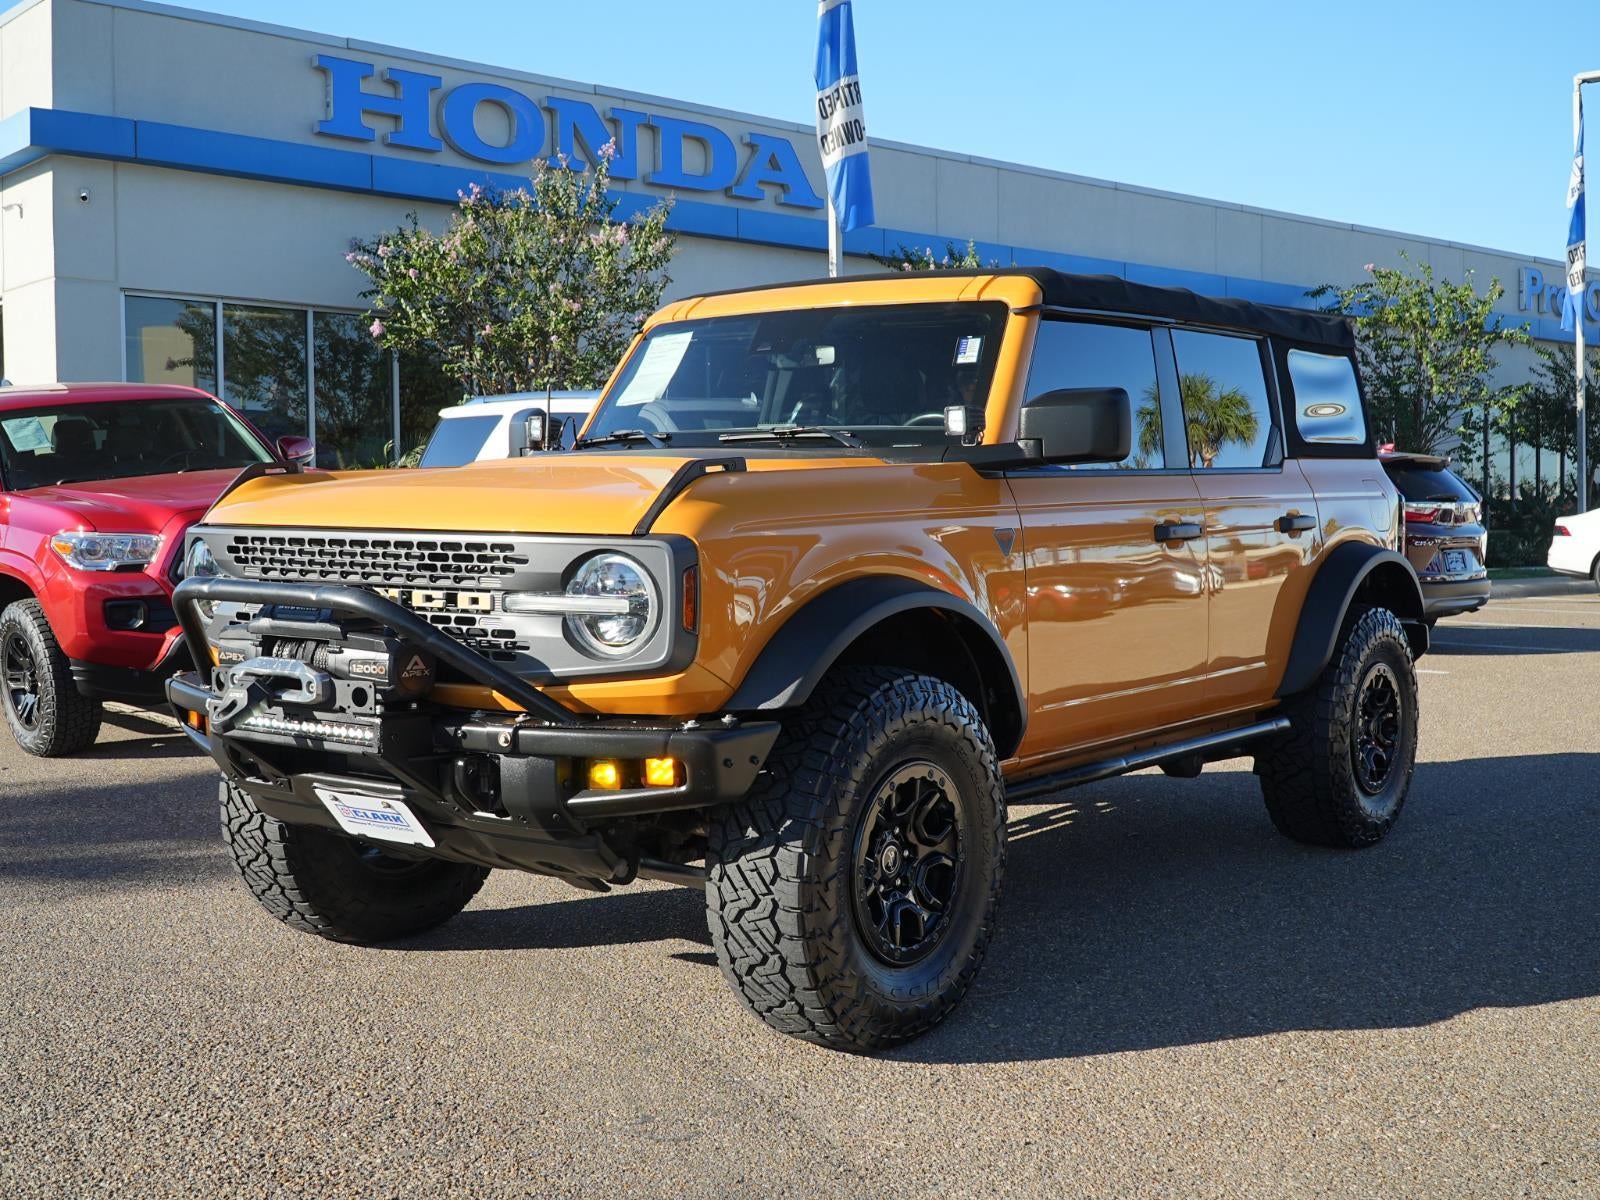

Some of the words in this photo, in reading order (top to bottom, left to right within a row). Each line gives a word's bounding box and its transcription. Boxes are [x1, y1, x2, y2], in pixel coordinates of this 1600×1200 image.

[311, 54, 825, 209] HONDA
[219, 651, 245, 662] APEX
[351, 663, 386, 675] 12000
[401, 669, 430, 678] APEX
[352, 809, 404, 823] CLARK
